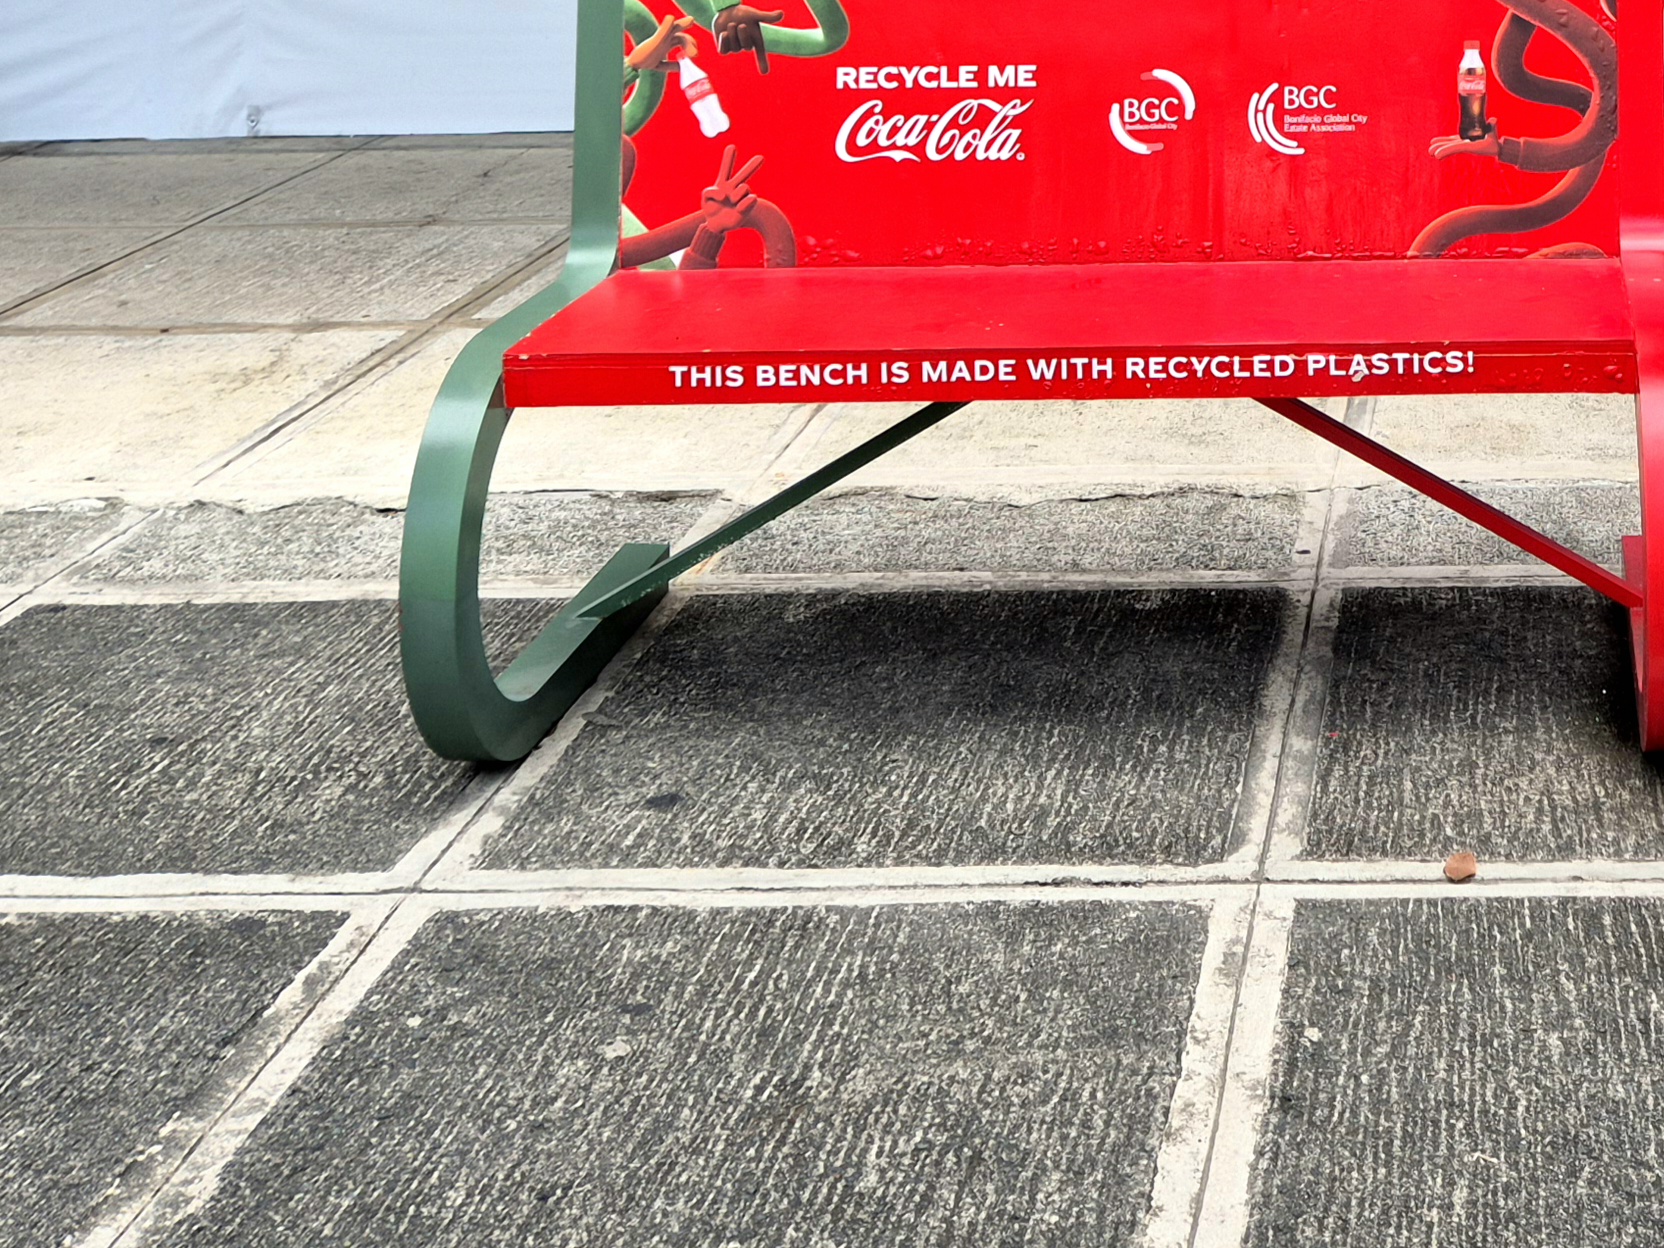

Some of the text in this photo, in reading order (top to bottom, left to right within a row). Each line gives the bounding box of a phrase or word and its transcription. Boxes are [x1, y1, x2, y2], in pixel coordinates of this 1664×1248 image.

[836, 64, 1038, 90] RECYCLE ME
[1123, 97, 1179, 122] BGC
[1283, 85, 1337, 109] BGC
[835, 98, 1035, 163] Coca-Cola
[1324, 114, 1350, 123] Global
[1351, 114, 1368, 124] City
[668, 350, 1475, 388] THIS BENCH IS MADE WITH RECYCLED PLASTICS!
